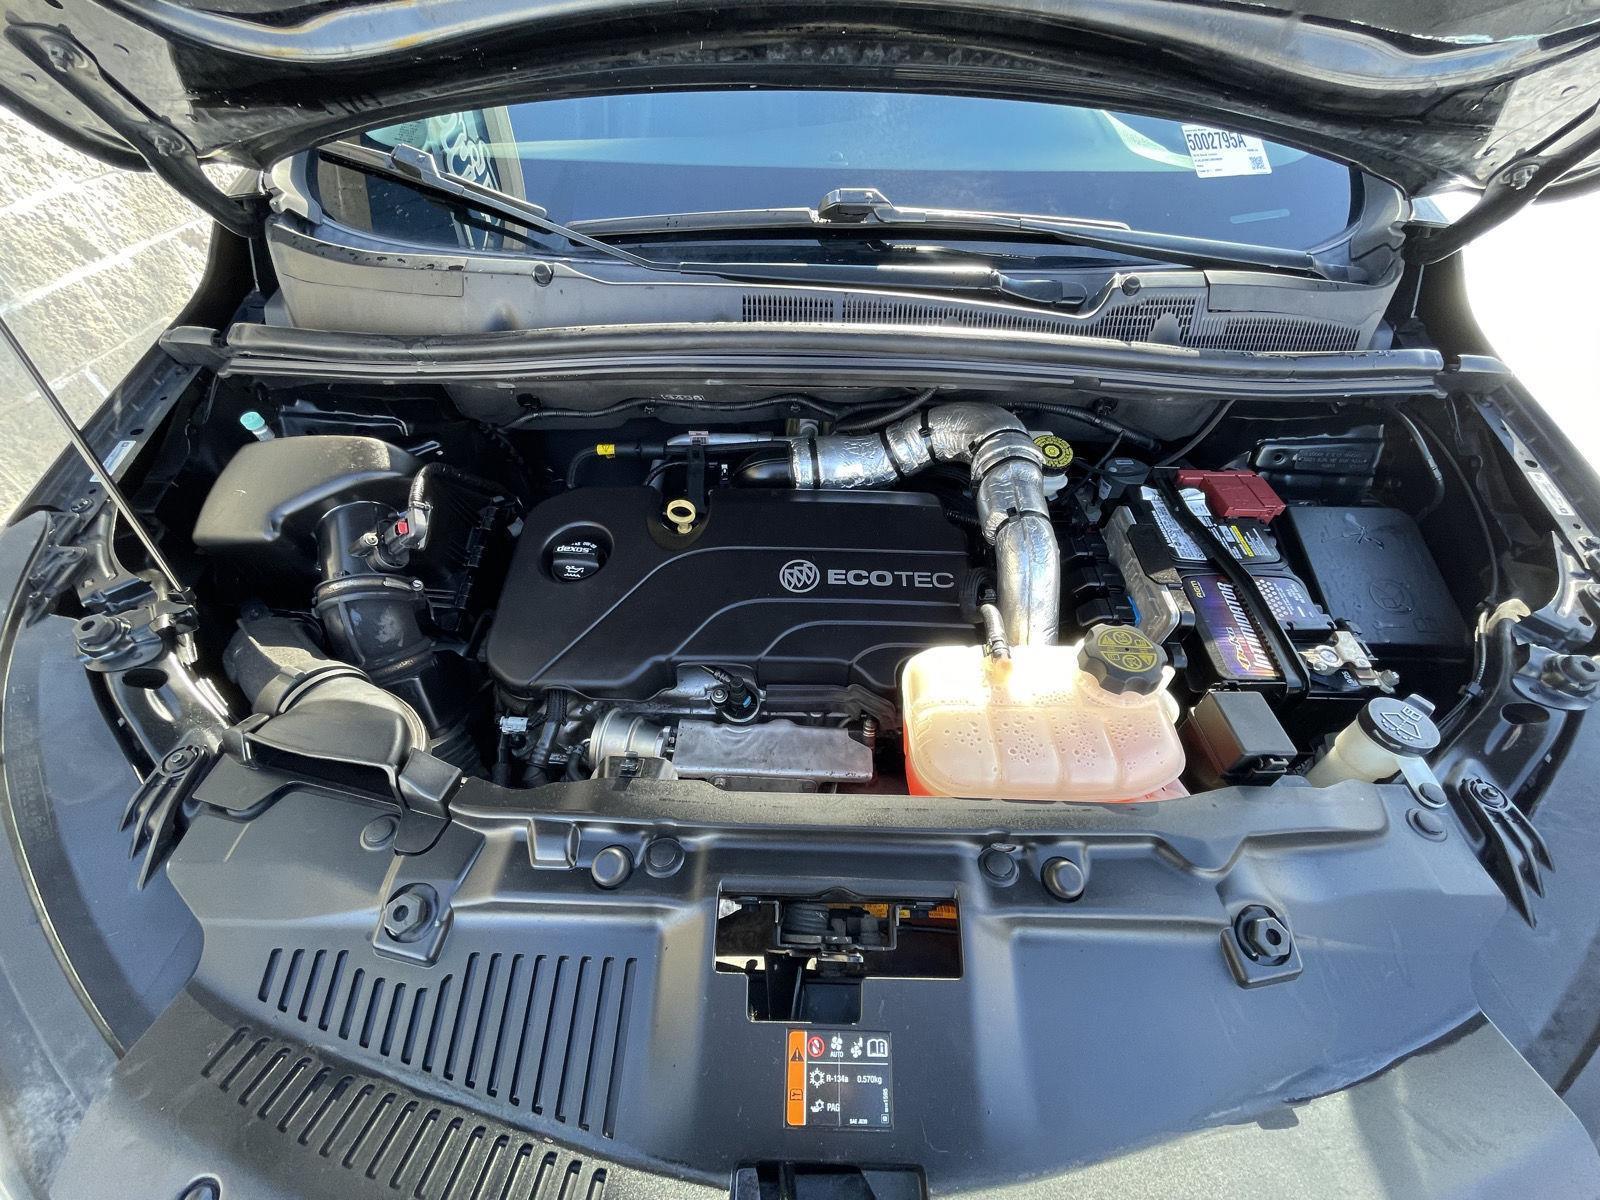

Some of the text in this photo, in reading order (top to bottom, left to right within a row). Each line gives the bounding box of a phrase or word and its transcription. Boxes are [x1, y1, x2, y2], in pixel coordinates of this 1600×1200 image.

[1185, 131, 1247, 151] 5002795A
[556, 545, 590, 553] dexos
[827, 569, 955, 588] ECOTEC
[826, 1074, 882, 1084] R-134a 0.570kg
[826, 1103, 840, 1112] PAG
